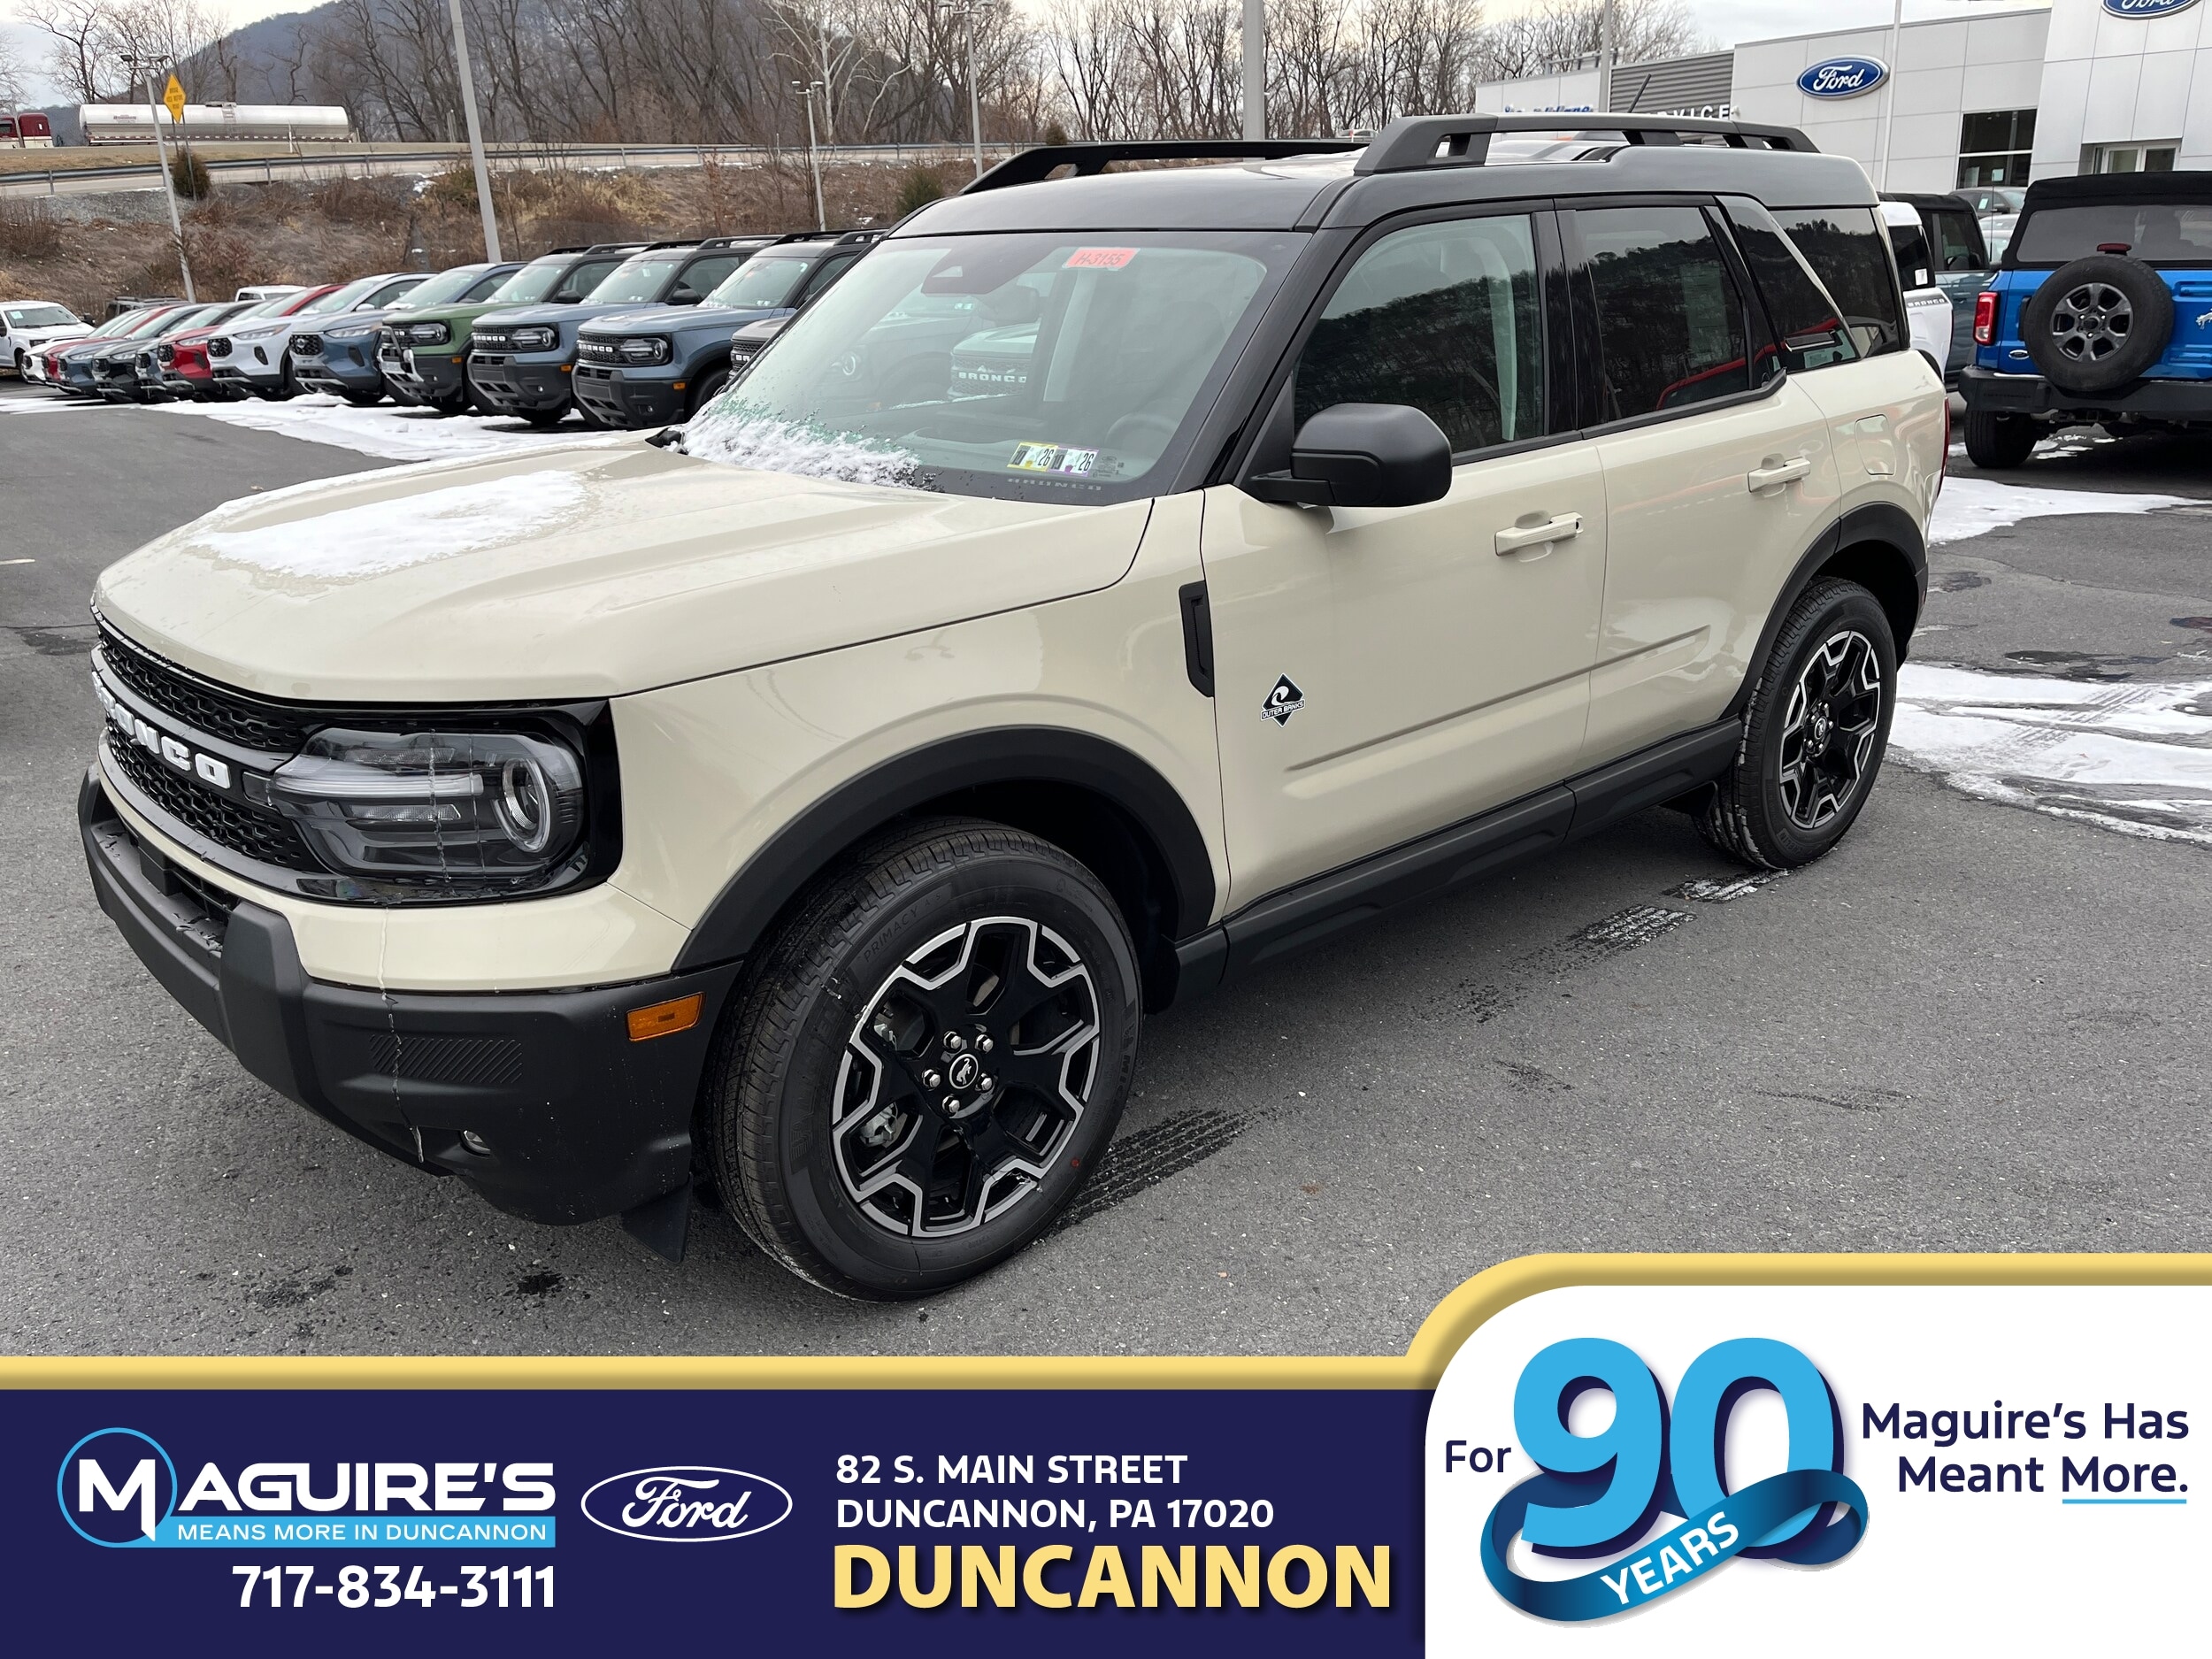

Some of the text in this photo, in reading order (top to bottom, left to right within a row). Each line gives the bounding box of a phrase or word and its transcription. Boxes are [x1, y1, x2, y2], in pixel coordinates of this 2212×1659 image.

[1812, 65, 1865, 91] Ford
[1907, 298, 1945, 307] BRONCO
[958, 372, 1027, 383] BRONCO
[1038, 449, 1054, 467] 26
[1079, 453, 1094, 472] 26
[1262, 701, 1304, 718] OUTER BANKS
[864, 906, 918, 962] PRIMACY
